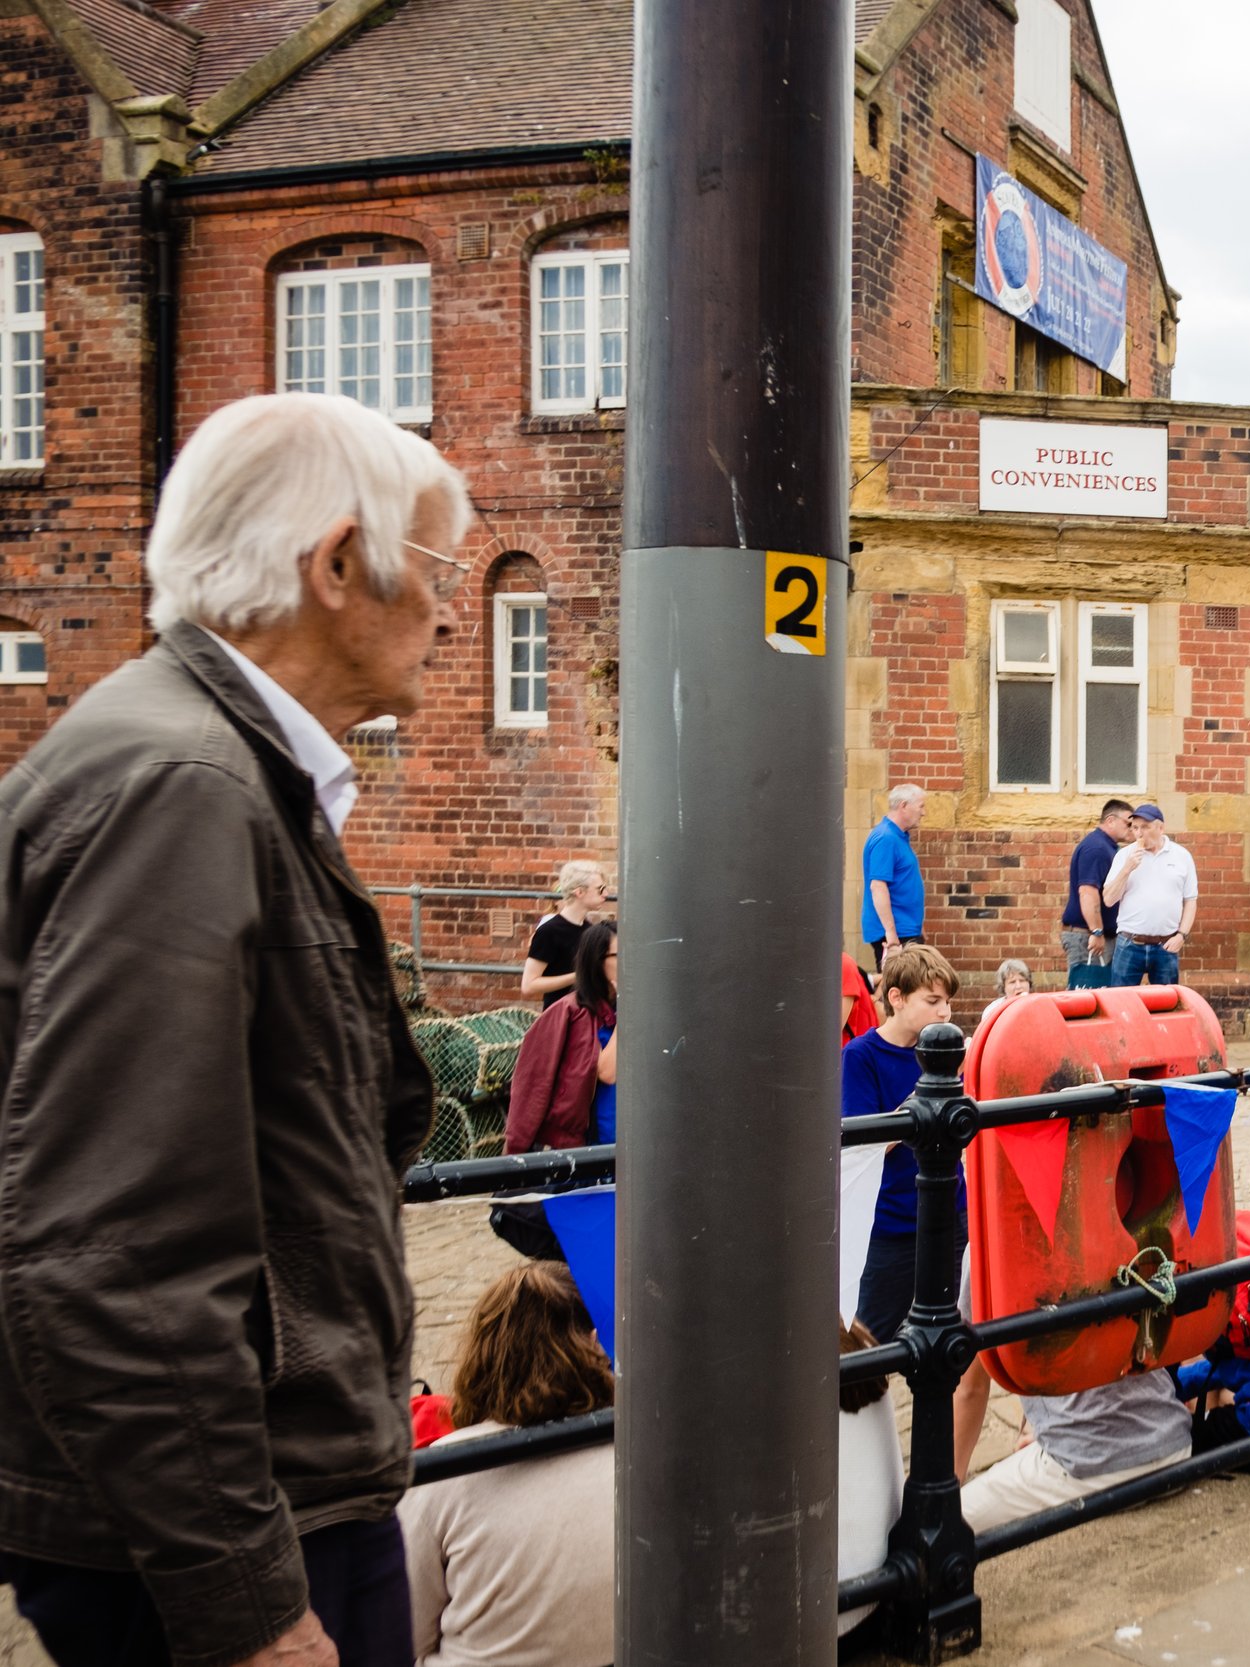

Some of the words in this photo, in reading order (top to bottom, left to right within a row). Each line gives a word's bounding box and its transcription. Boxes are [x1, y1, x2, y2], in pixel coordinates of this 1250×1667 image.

[1036, 447, 1114, 467] PUBLIC
[991, 469, 1157, 493] CONVENIENCES
[774, 565, 818, 638] 2
